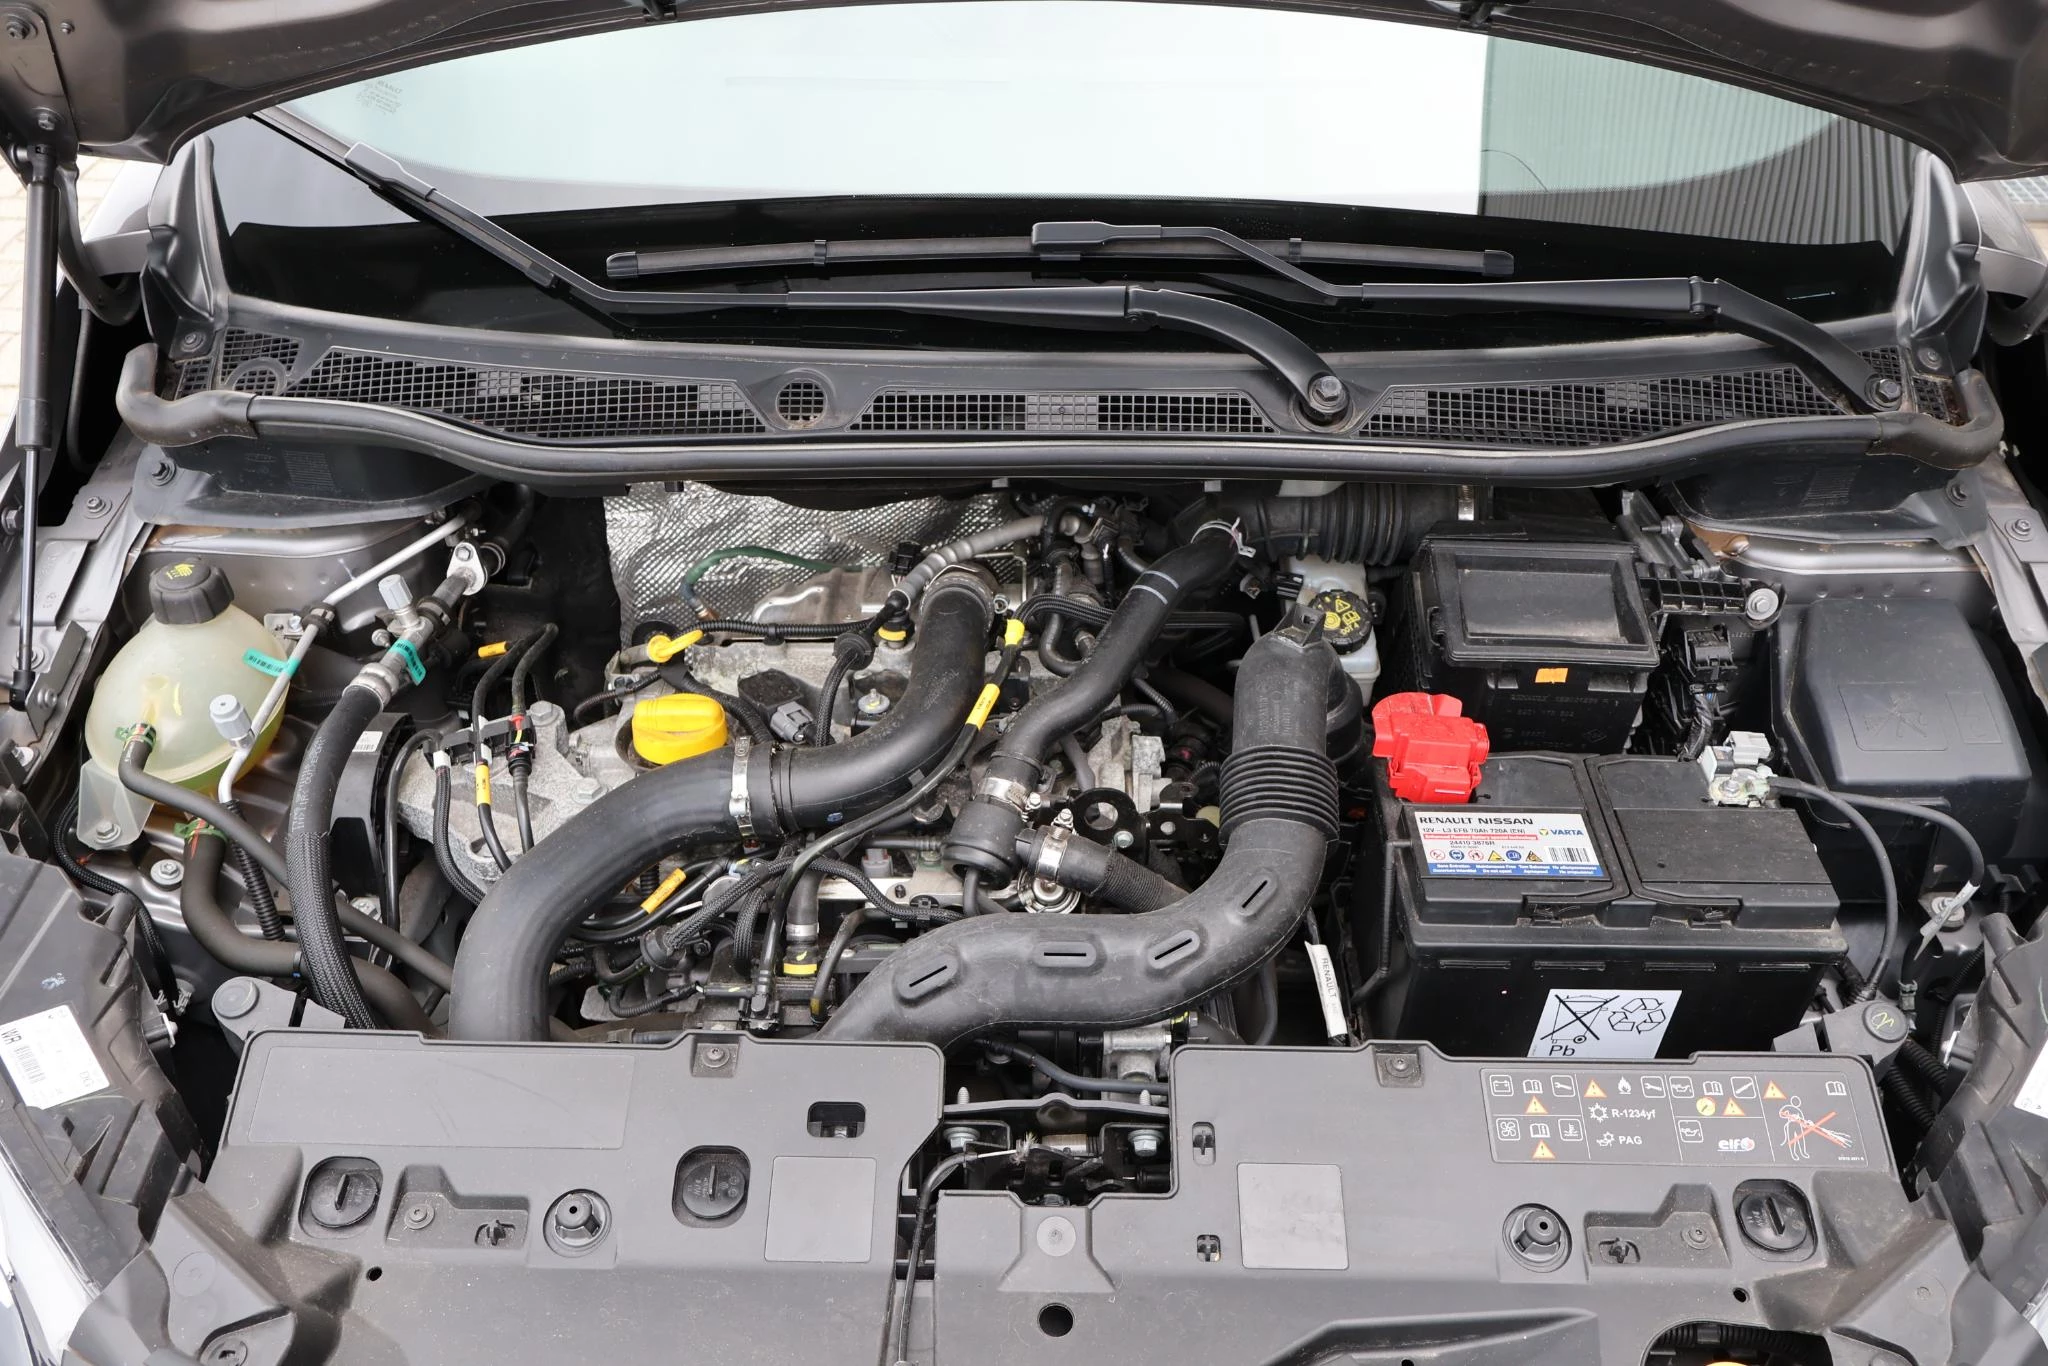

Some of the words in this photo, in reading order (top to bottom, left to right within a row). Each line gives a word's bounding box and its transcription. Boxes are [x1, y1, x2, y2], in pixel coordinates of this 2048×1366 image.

[1322, 957, 1337, 998] RENAULT
[1549, 1044, 1576, 1056] Pb
[1611, 1108, 1656, 1121] R-1234yf
[1618, 1135, 1643, 1145] PAG
[1717, 1138, 1741, 1151] elf
